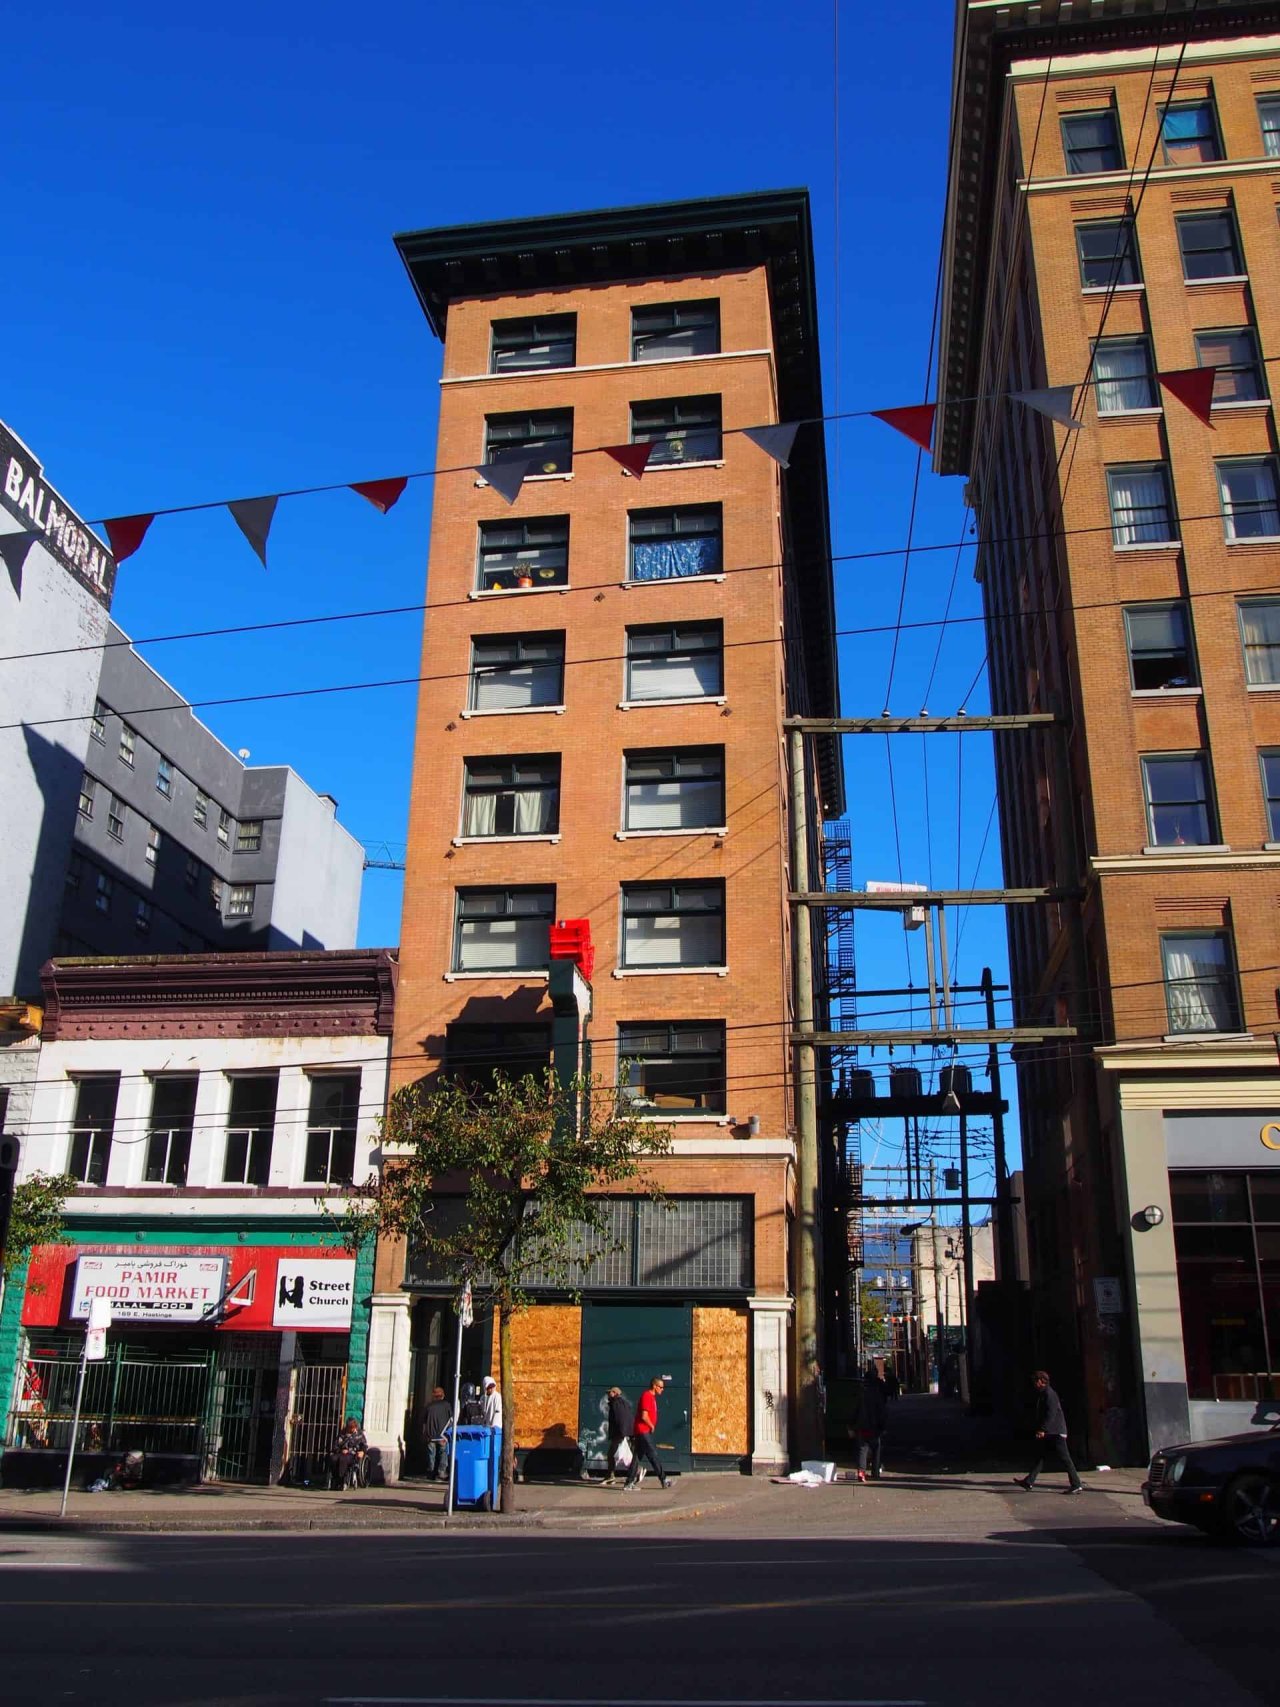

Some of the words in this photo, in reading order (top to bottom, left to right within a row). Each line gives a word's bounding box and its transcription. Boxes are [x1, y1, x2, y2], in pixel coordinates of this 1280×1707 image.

[4, 456, 108, 593] BALMORAL
[121, 1270, 177, 1283] PAMIR
[85, 1285, 129, 1298] FOOD
[137, 1287, 210, 1299] MARKET
[309, 1280, 351, 1291] Street
[309, 1296, 349, 1305] Church
